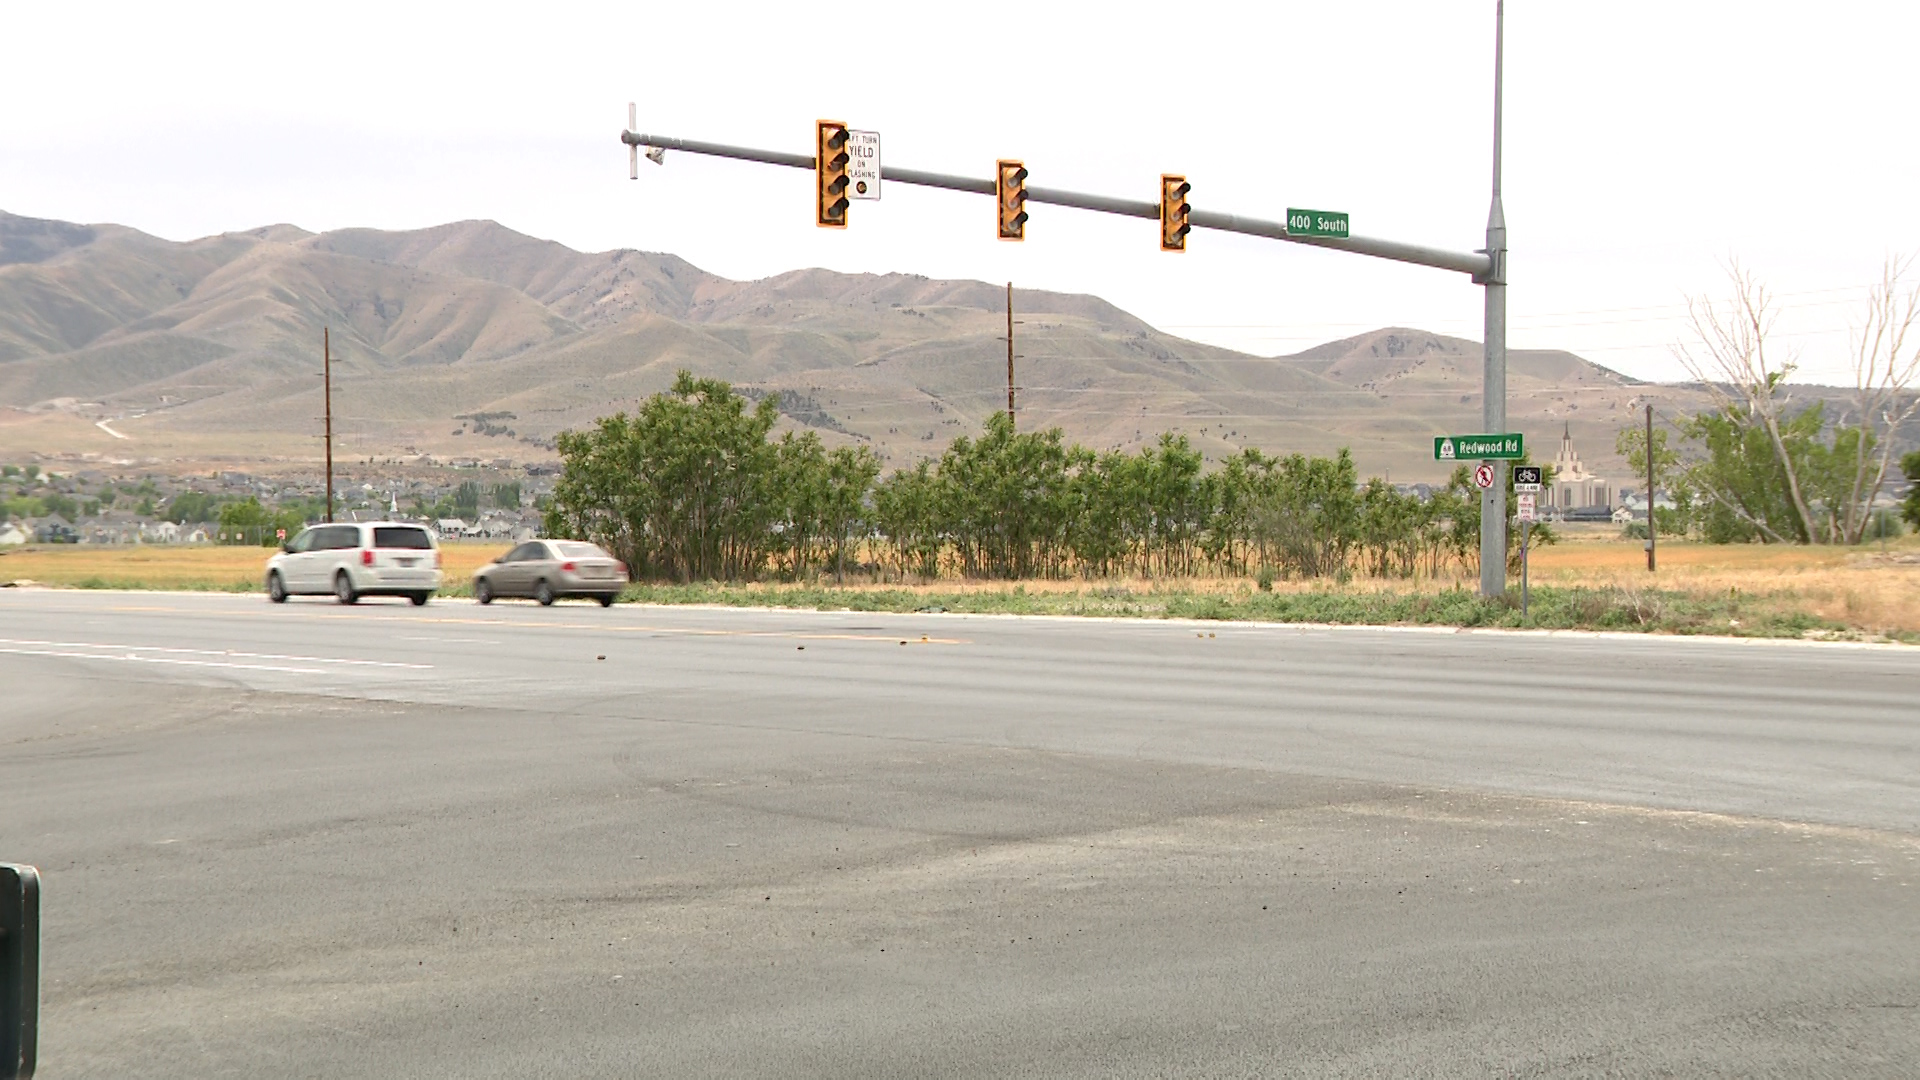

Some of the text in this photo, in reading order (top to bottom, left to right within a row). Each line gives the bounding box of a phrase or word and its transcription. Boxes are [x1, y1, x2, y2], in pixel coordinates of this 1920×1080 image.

[862, 135, 877, 144] TURN
[849, 145, 874, 158] YIELD
[857, 159, 866, 168] ON
[1289, 215, 1347, 232] 400 South
[1459, 439, 1518, 454] Redwood Rd
